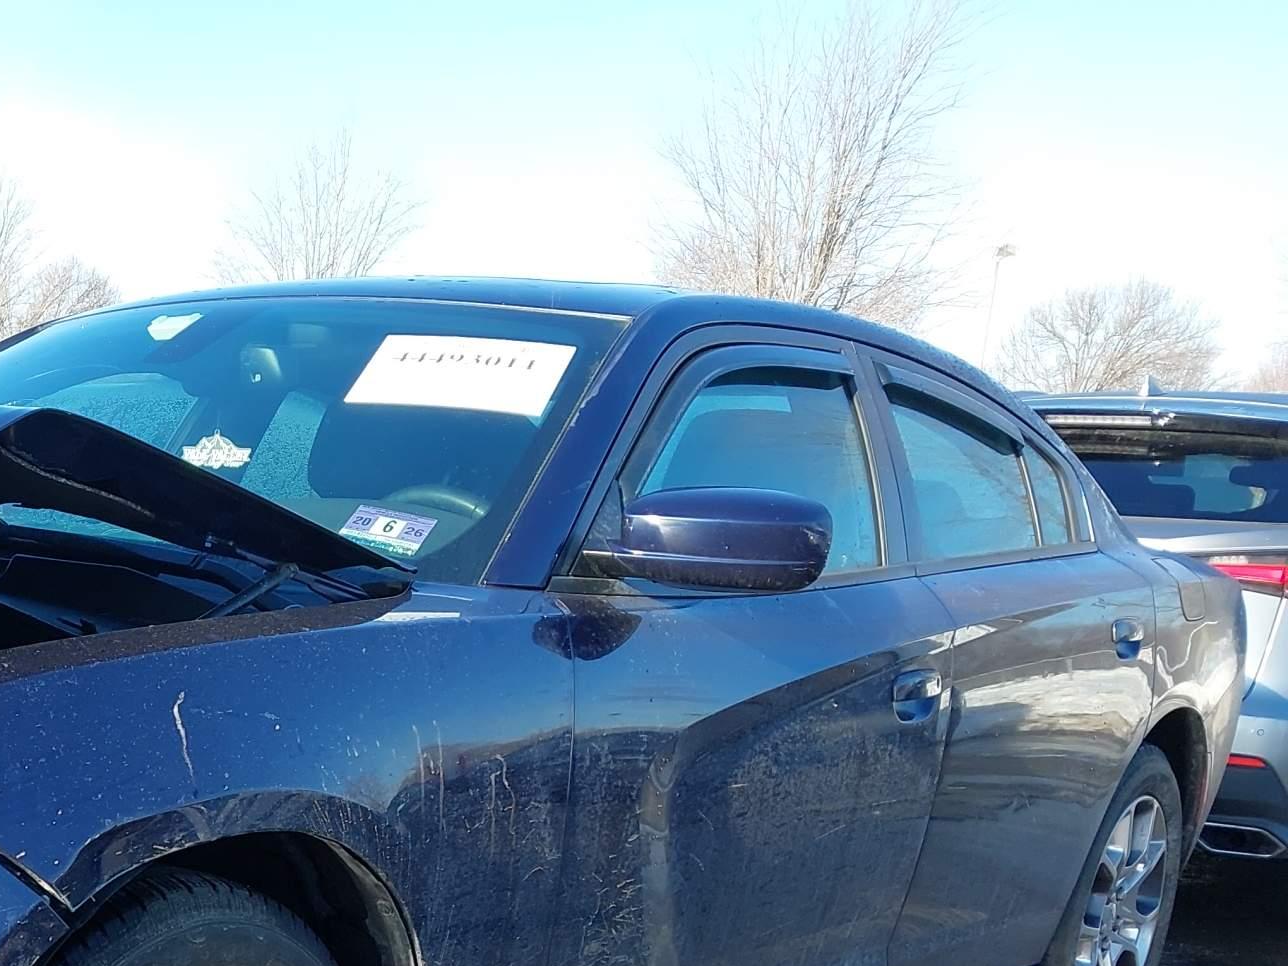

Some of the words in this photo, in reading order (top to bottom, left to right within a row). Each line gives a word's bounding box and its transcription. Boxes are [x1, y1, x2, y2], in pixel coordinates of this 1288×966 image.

[352, 515, 372, 526] 20
[383, 520, 397, 533] 6
[404, 526, 424, 537] 26
